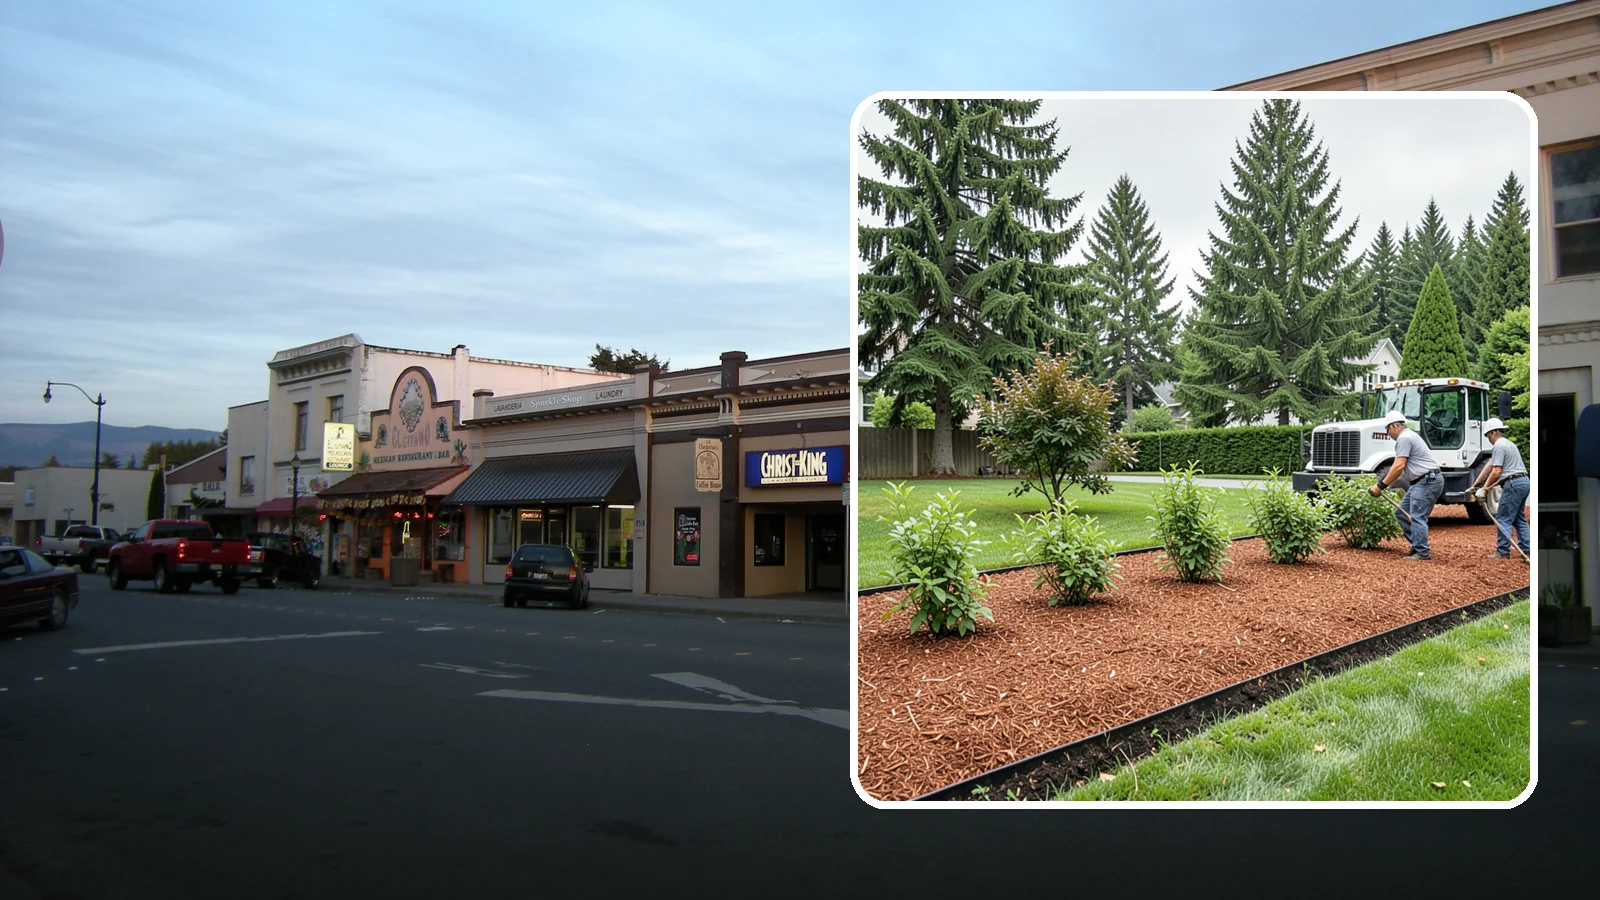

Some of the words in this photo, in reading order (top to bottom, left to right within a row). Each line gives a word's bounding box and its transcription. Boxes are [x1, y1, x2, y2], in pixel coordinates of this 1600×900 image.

[562, 394, 583, 406] Shop
[595, 389, 623, 400] LAUNDRY
[493, 402, 523, 412] LAVANDERIA
[373, 455, 396, 464] MEXICAN
[397, 451, 433, 462] RESTAURANT
[438, 450, 450, 458] BAR
[761, 452, 797, 478] CHRIST
[799, 450, 827, 476] KING
